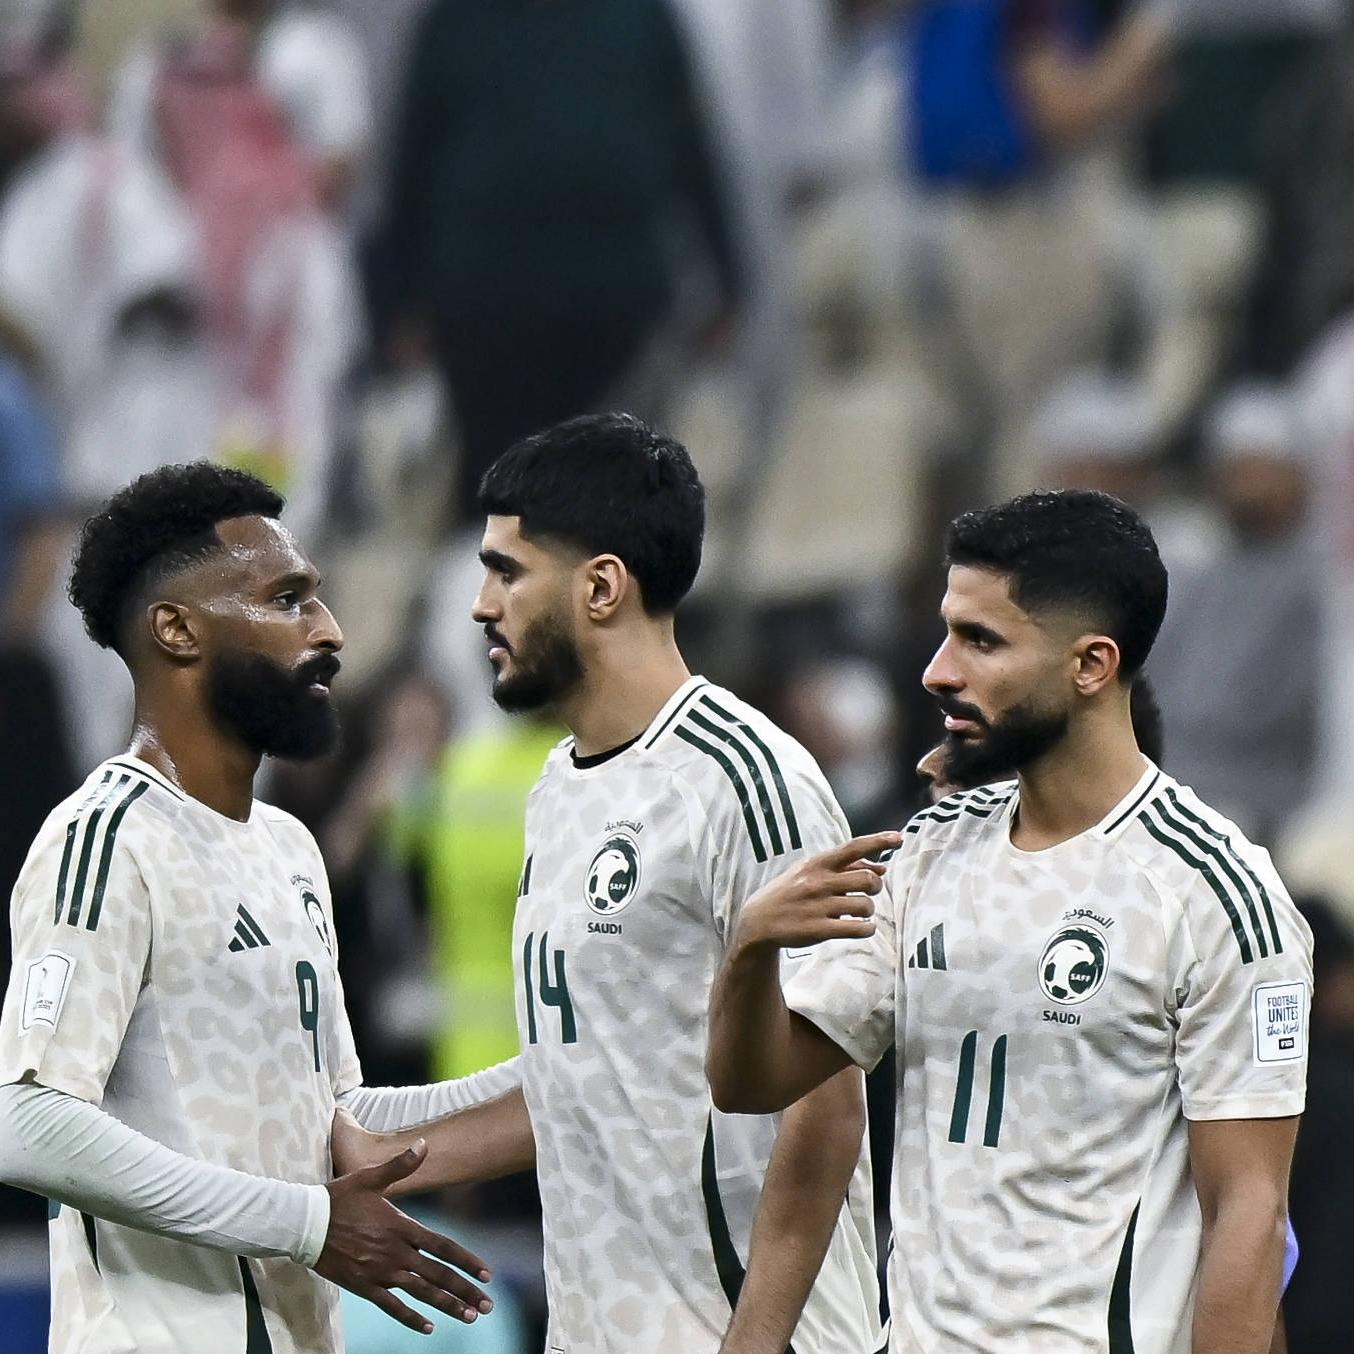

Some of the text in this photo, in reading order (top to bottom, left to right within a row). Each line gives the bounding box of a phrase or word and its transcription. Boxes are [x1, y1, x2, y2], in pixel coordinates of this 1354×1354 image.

[587, 921, 623, 935] SAUDI
[296, 960, 321, 1073] 9
[523, 931, 577, 1044] 14
[1042, 1010, 1082, 1026] SAUDI
[1268, 1006, 1300, 1024] UNITES
[948, 1029, 1008, 1148] 11
